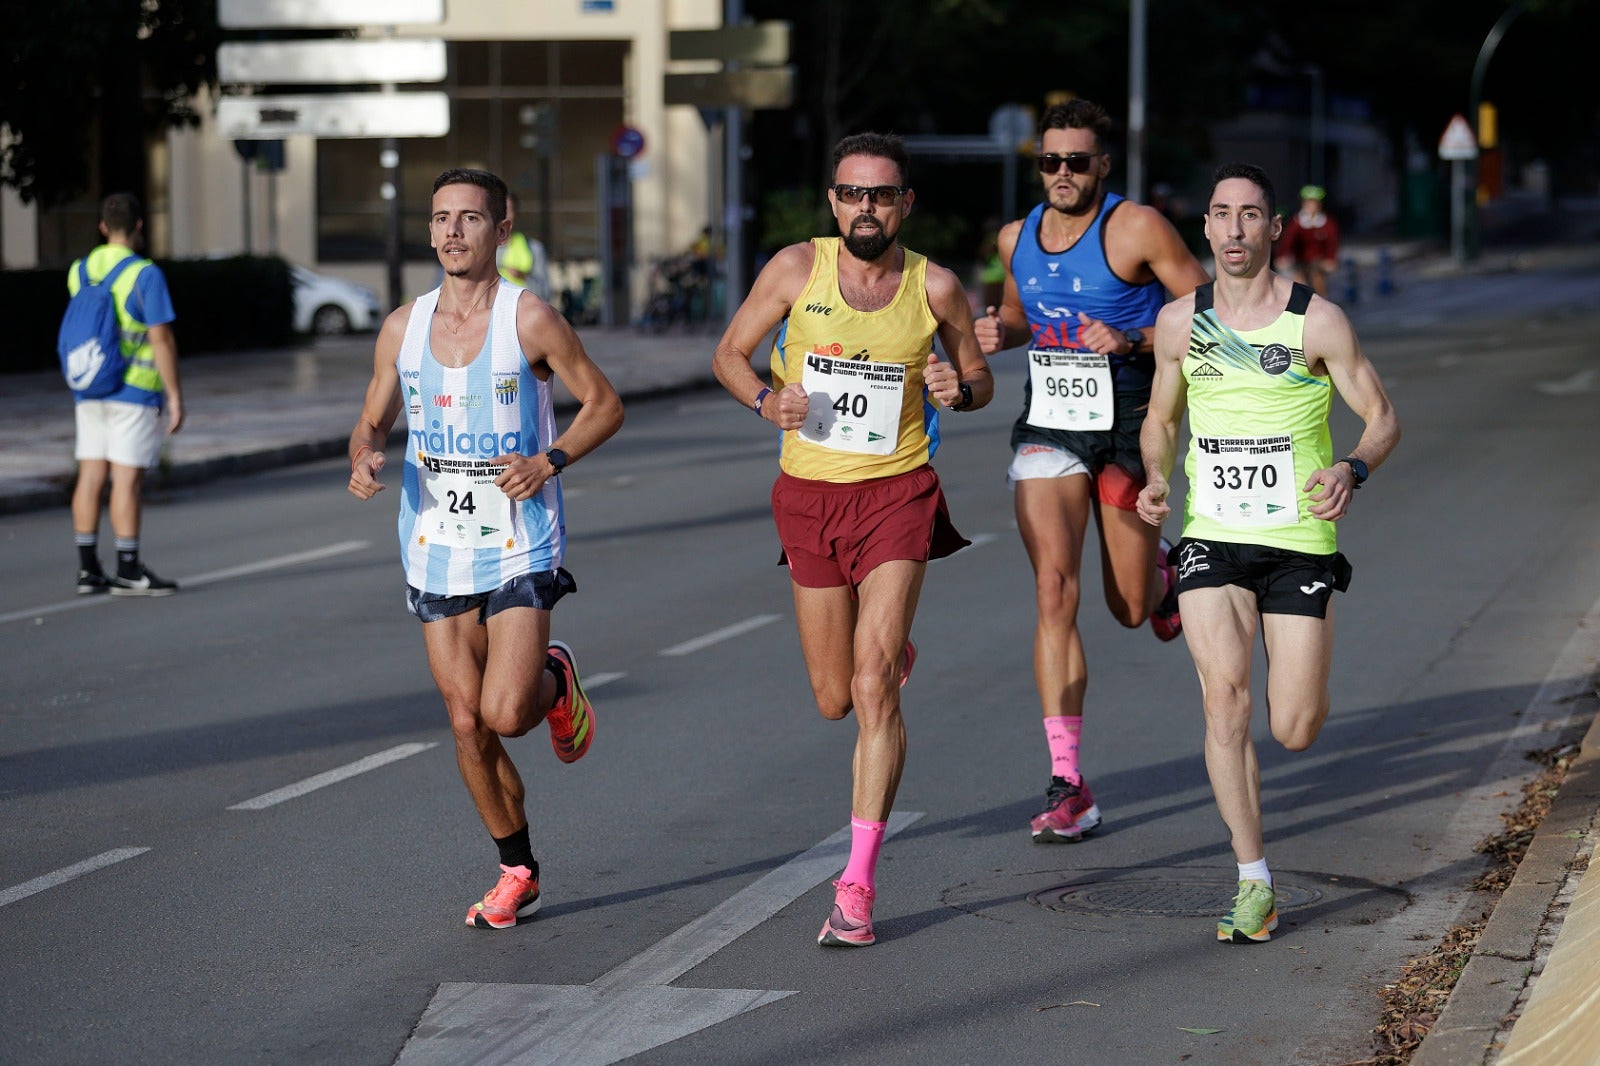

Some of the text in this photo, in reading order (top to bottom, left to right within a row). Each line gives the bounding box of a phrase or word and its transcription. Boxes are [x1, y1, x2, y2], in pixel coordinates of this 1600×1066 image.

[807, 355, 905, 375] 43 CARRERA URBANA
[1032, 353, 1051, 367] 43
[833, 368, 857, 377] CIUDAD
[1046, 376, 1098, 398] 9650
[832, 392, 868, 418] 40
[1197, 436, 1290, 454] 43 CARRERA URBANA
[423, 456, 441, 474] 43
[440, 459, 472, 468] CARRERA
[441, 466, 460, 474] CIUDAD
[1213, 464, 1278, 490] 3370
[447, 490, 476, 515] 24
